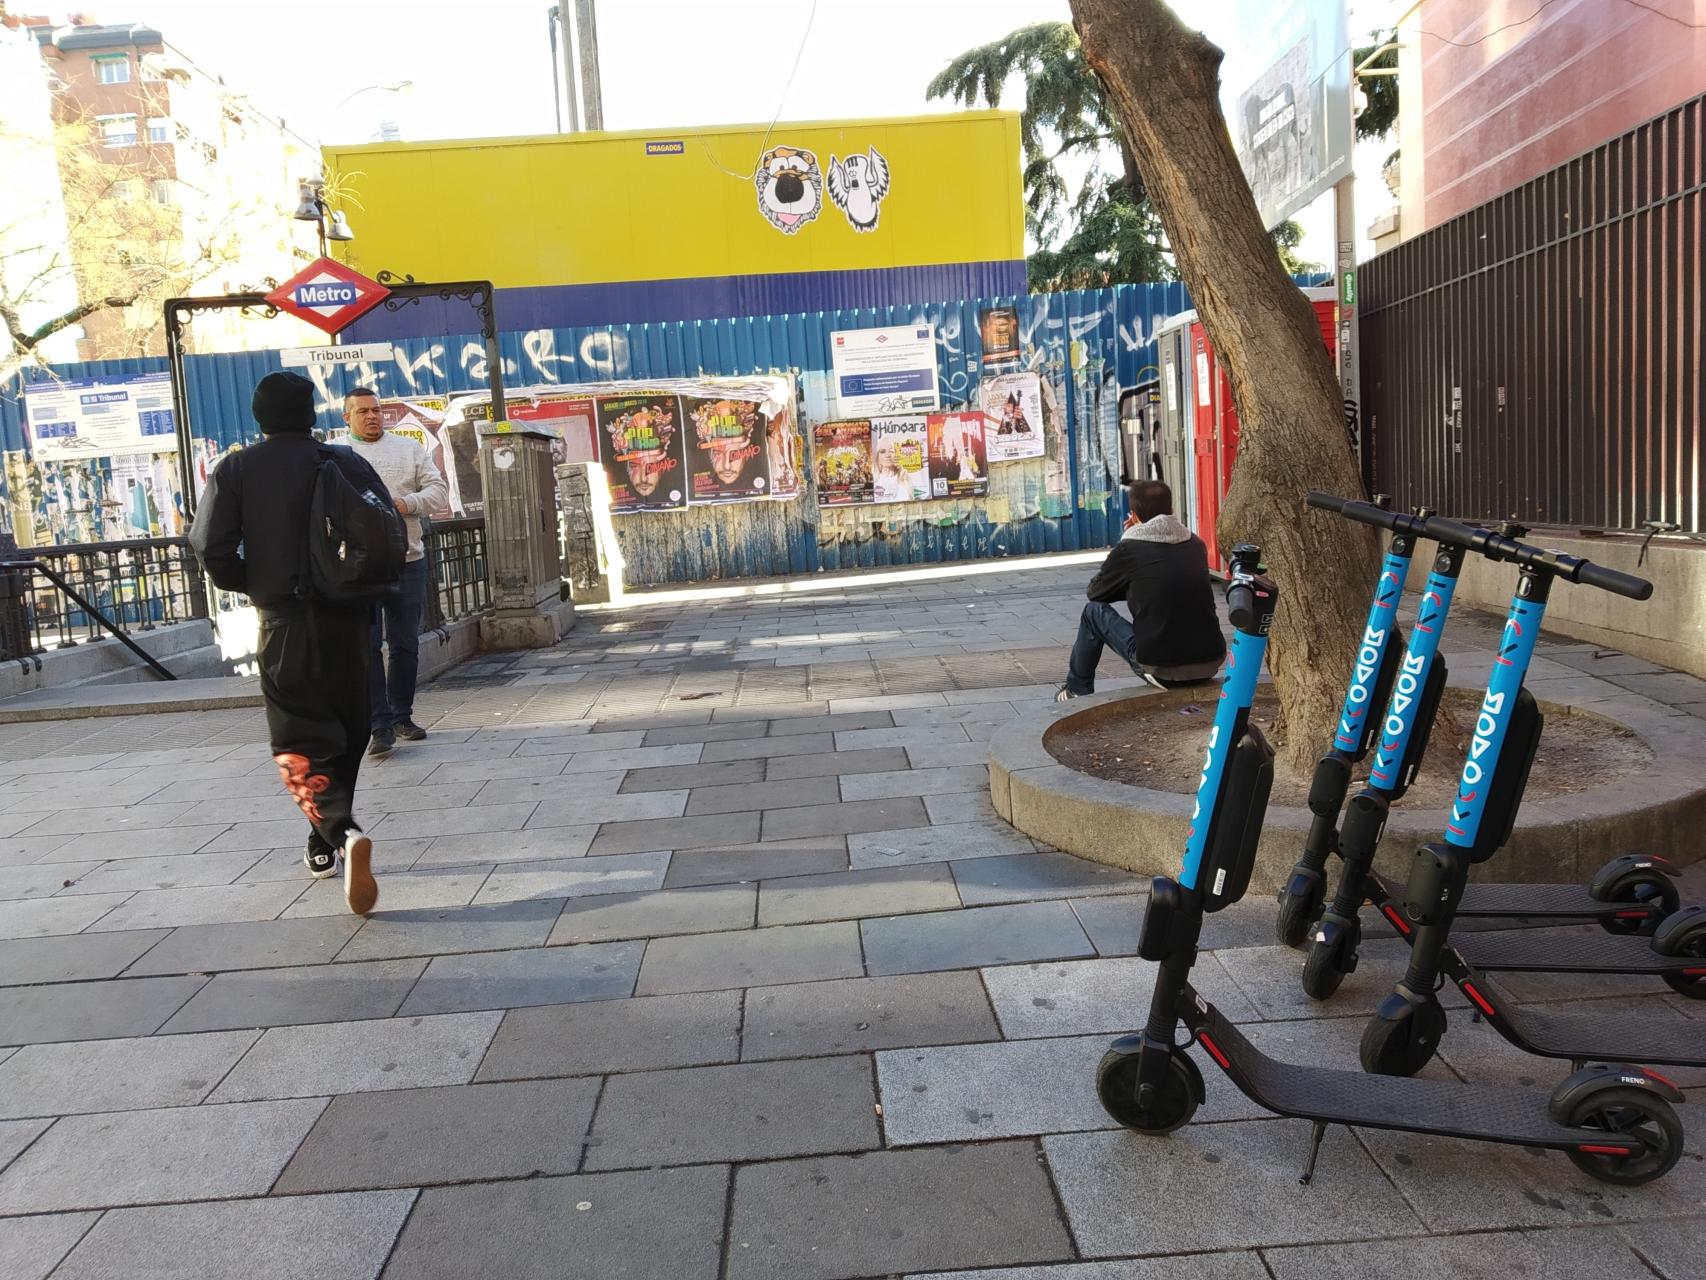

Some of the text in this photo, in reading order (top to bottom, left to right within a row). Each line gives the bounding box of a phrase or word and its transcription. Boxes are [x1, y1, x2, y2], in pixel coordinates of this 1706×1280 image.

[648, 143, 682, 153] DRAGADOS
[300, 287, 352, 304] Metro
[309, 348, 364, 362] Tribunal
[98, 392, 126, 401] Tribunal
[878, 420, 926, 439] Húngara
[936, 481, 945, 489] 10
[1349, 624, 1385, 703] MOVO
[1386, 650, 1425, 736] MOVO
[1462, 687, 1506, 785] MOVO
[1620, 1076, 1646, 1085] FRENO
